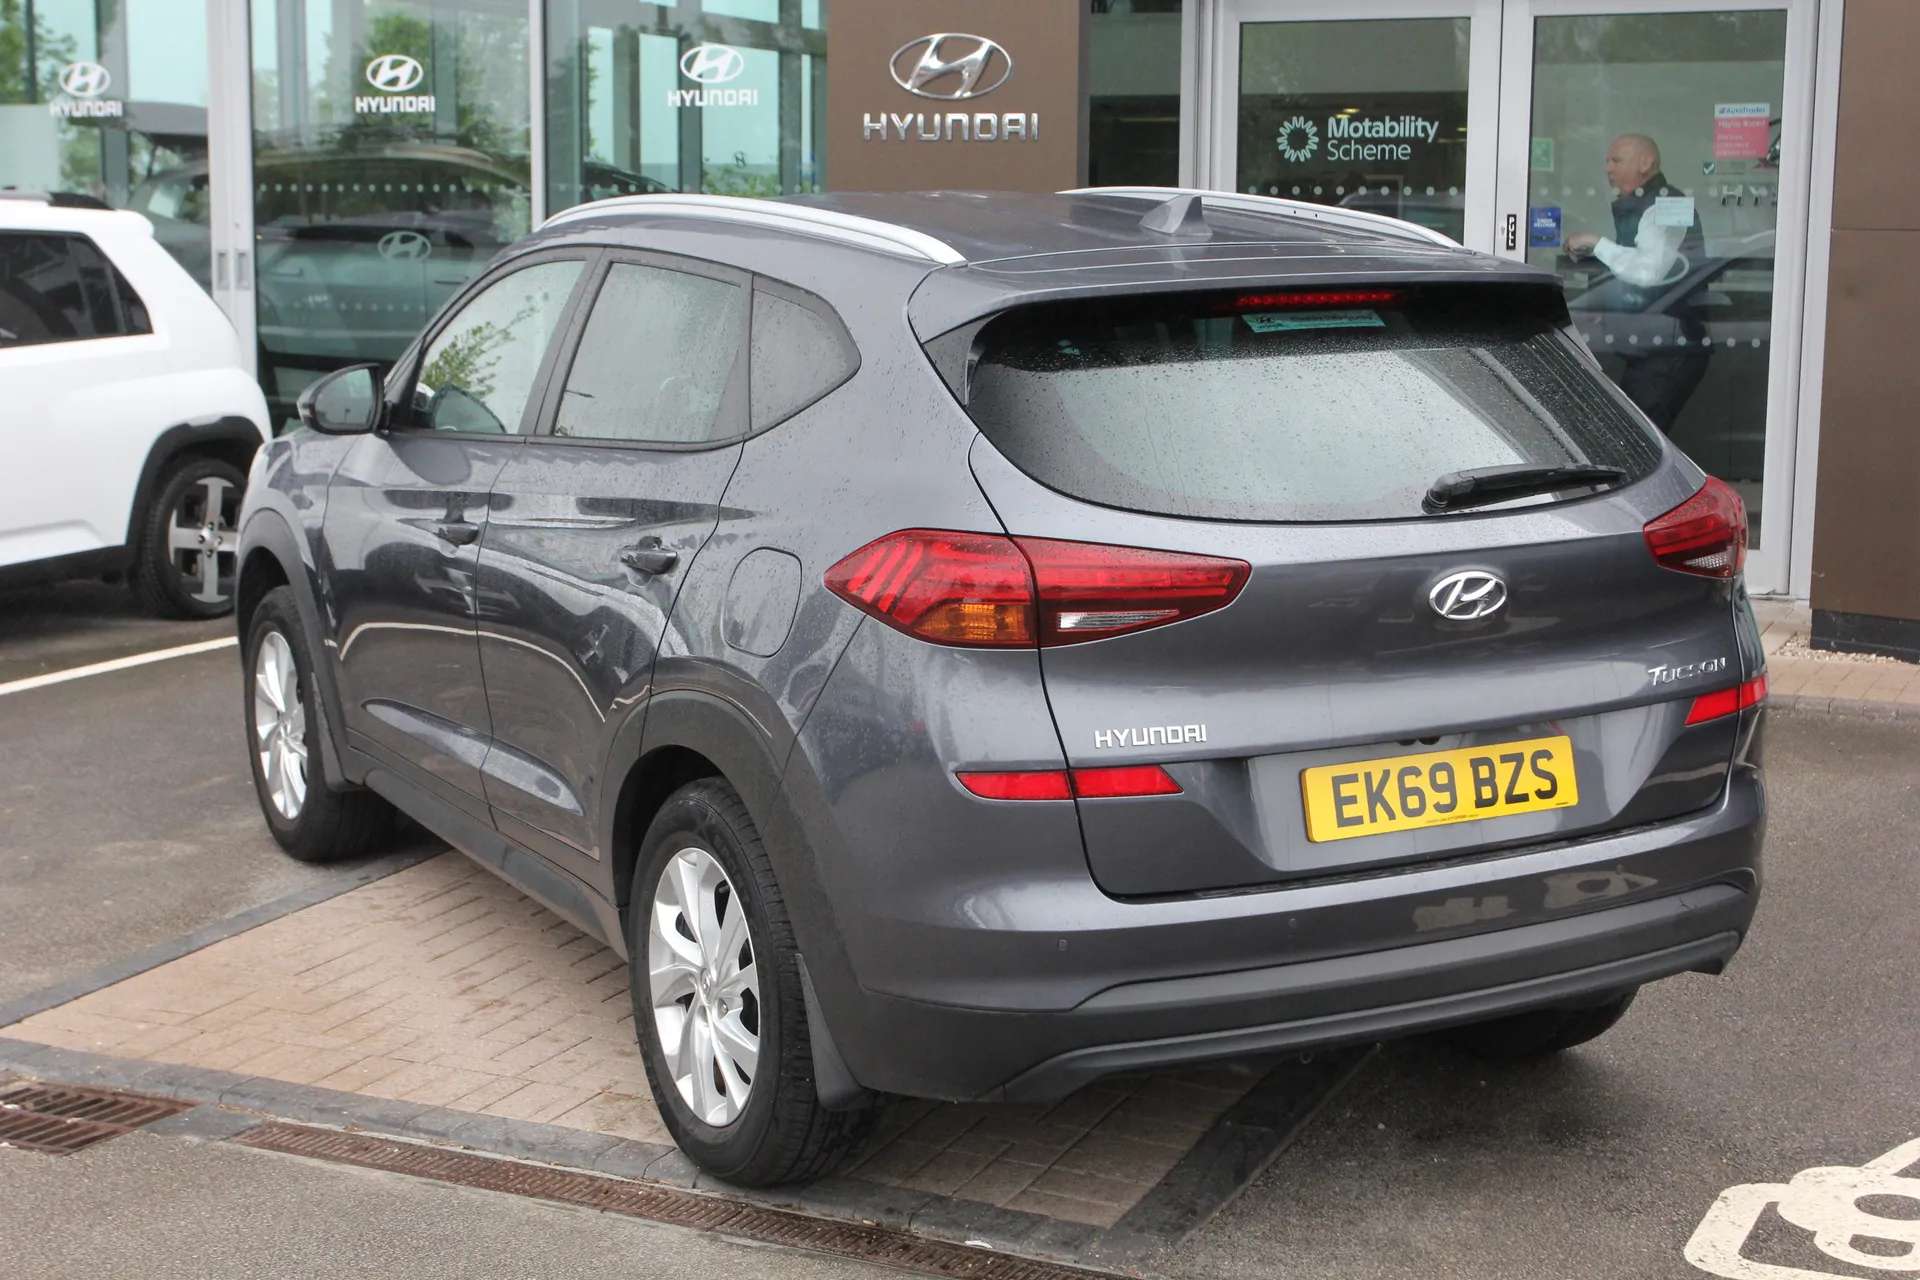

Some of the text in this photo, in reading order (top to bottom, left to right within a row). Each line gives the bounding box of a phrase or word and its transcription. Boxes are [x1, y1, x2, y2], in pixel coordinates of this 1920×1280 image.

[49, 100, 123, 117] HYUNDAI
[355, 96, 435, 112] HYUNDAI
[667, 89, 758, 107] HYUNDAI
[863, 112, 1038, 141] HYUNDAI
[1327, 115, 1439, 143] Motability
[1327, 139, 1412, 161] Scheme
[1094, 724, 1207, 748] HYUNDAI
[1331, 749, 1559, 829] EK69 BZS
